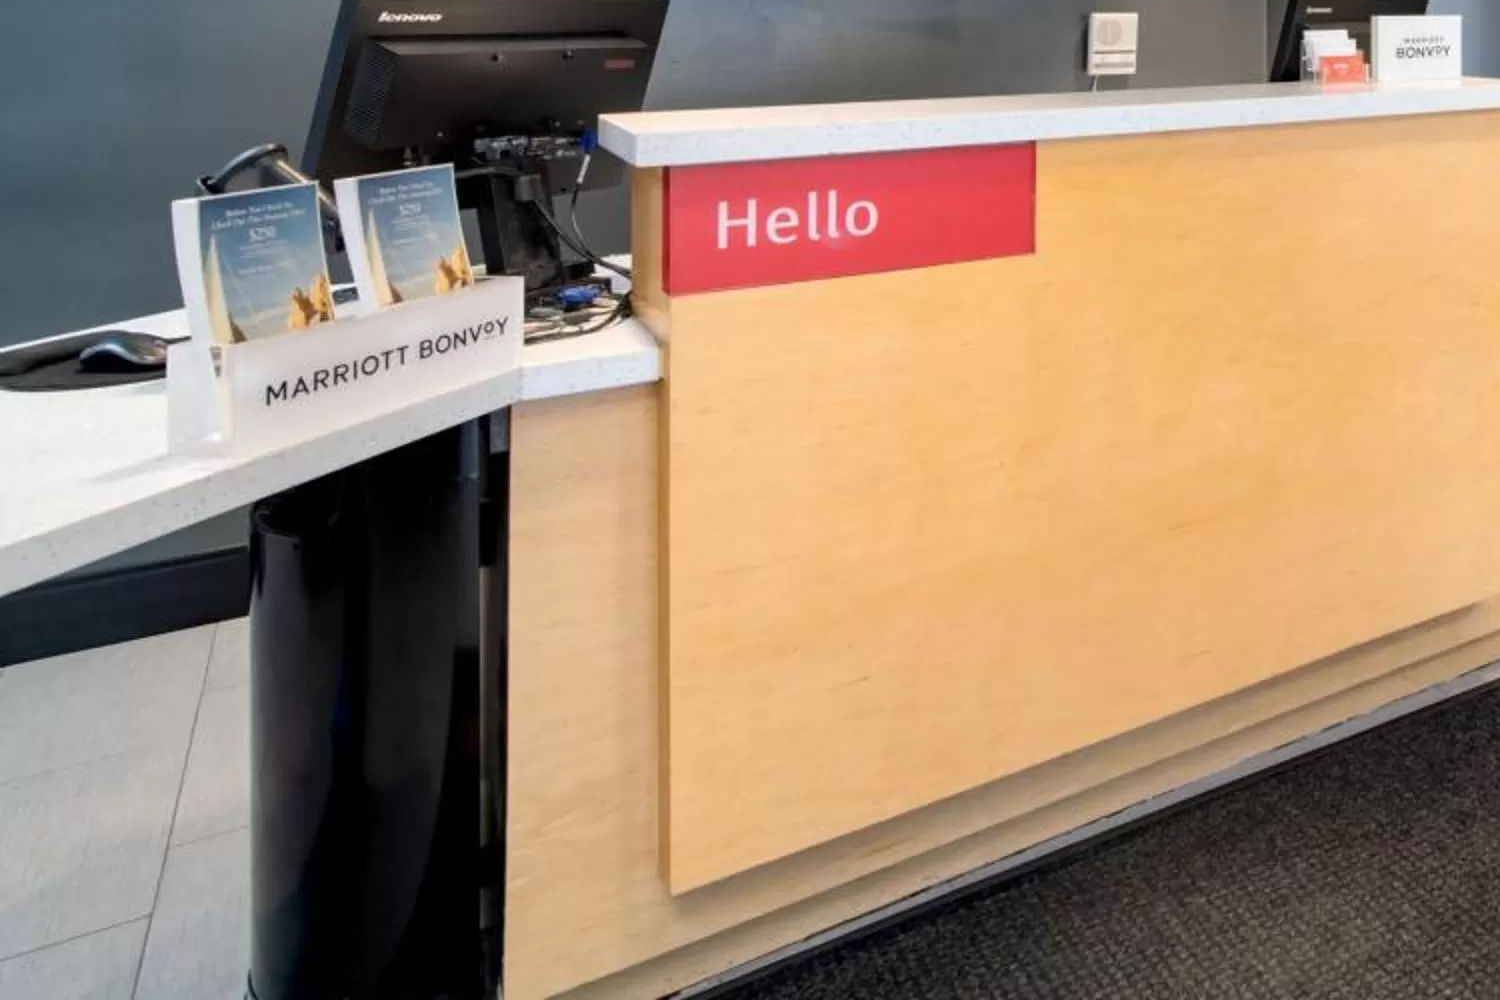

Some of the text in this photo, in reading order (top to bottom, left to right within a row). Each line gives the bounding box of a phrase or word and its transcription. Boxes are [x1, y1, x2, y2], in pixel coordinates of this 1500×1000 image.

[378, 11, 443, 23] lenovo
[717, 189, 879, 249] Hello
[264, 316, 509, 407] MARRIOTT BONVOY
